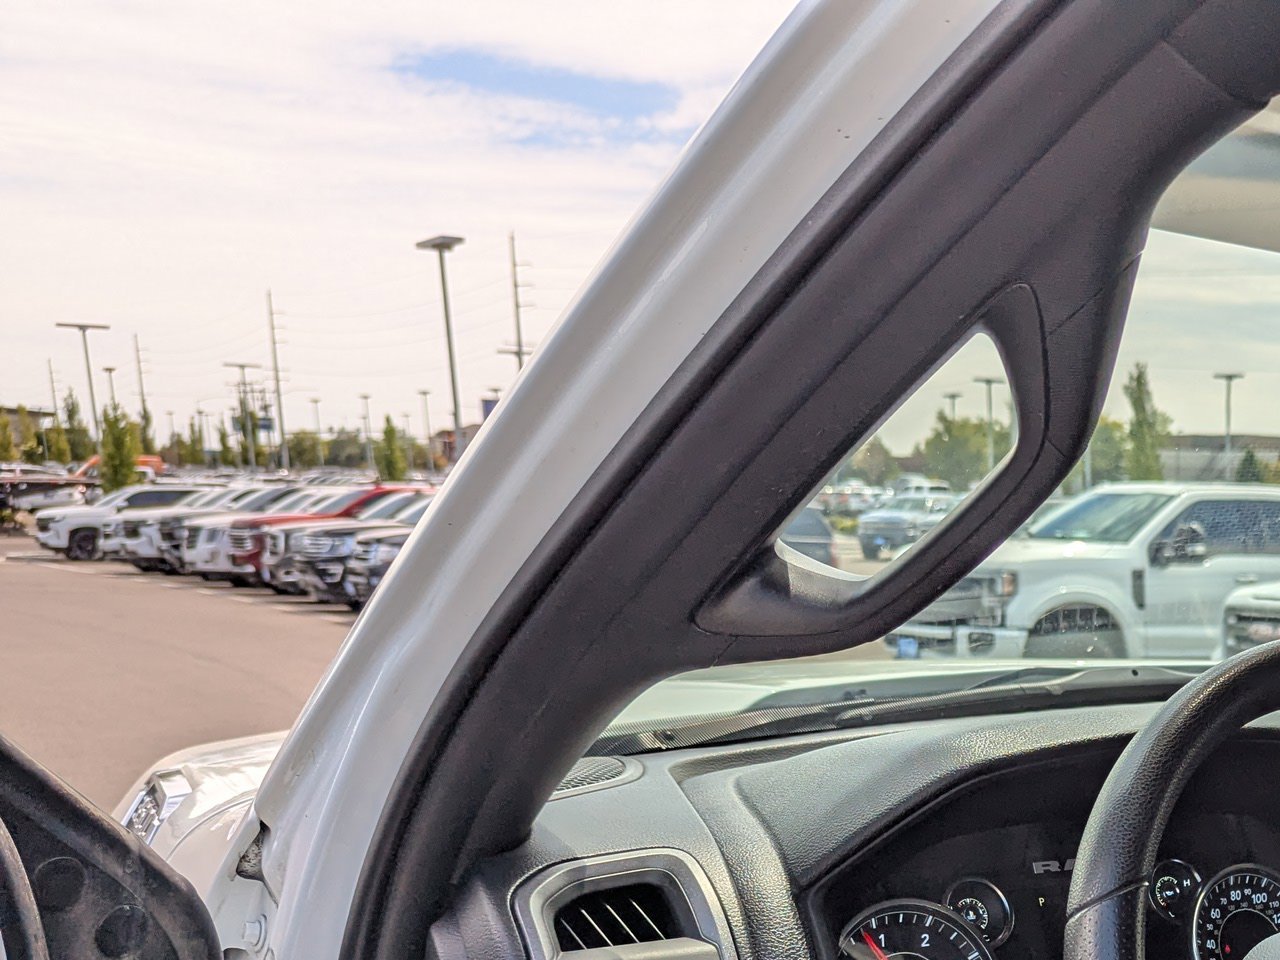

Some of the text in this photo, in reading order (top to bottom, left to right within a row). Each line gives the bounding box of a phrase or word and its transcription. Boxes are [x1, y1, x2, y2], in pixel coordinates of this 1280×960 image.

[1230, 890, 1242, 901] 80
[1244, 888, 1252, 896] 90
[1038, 897, 1045, 907] P
[1220, 897, 1228, 905] 70
[1251, 892, 1268, 904] 100
[1211, 907, 1221, 919] 60
[879, 934, 886, 947] 1
[921, 934, 930, 947] 2
[1206, 939, 1216, 949] 40
